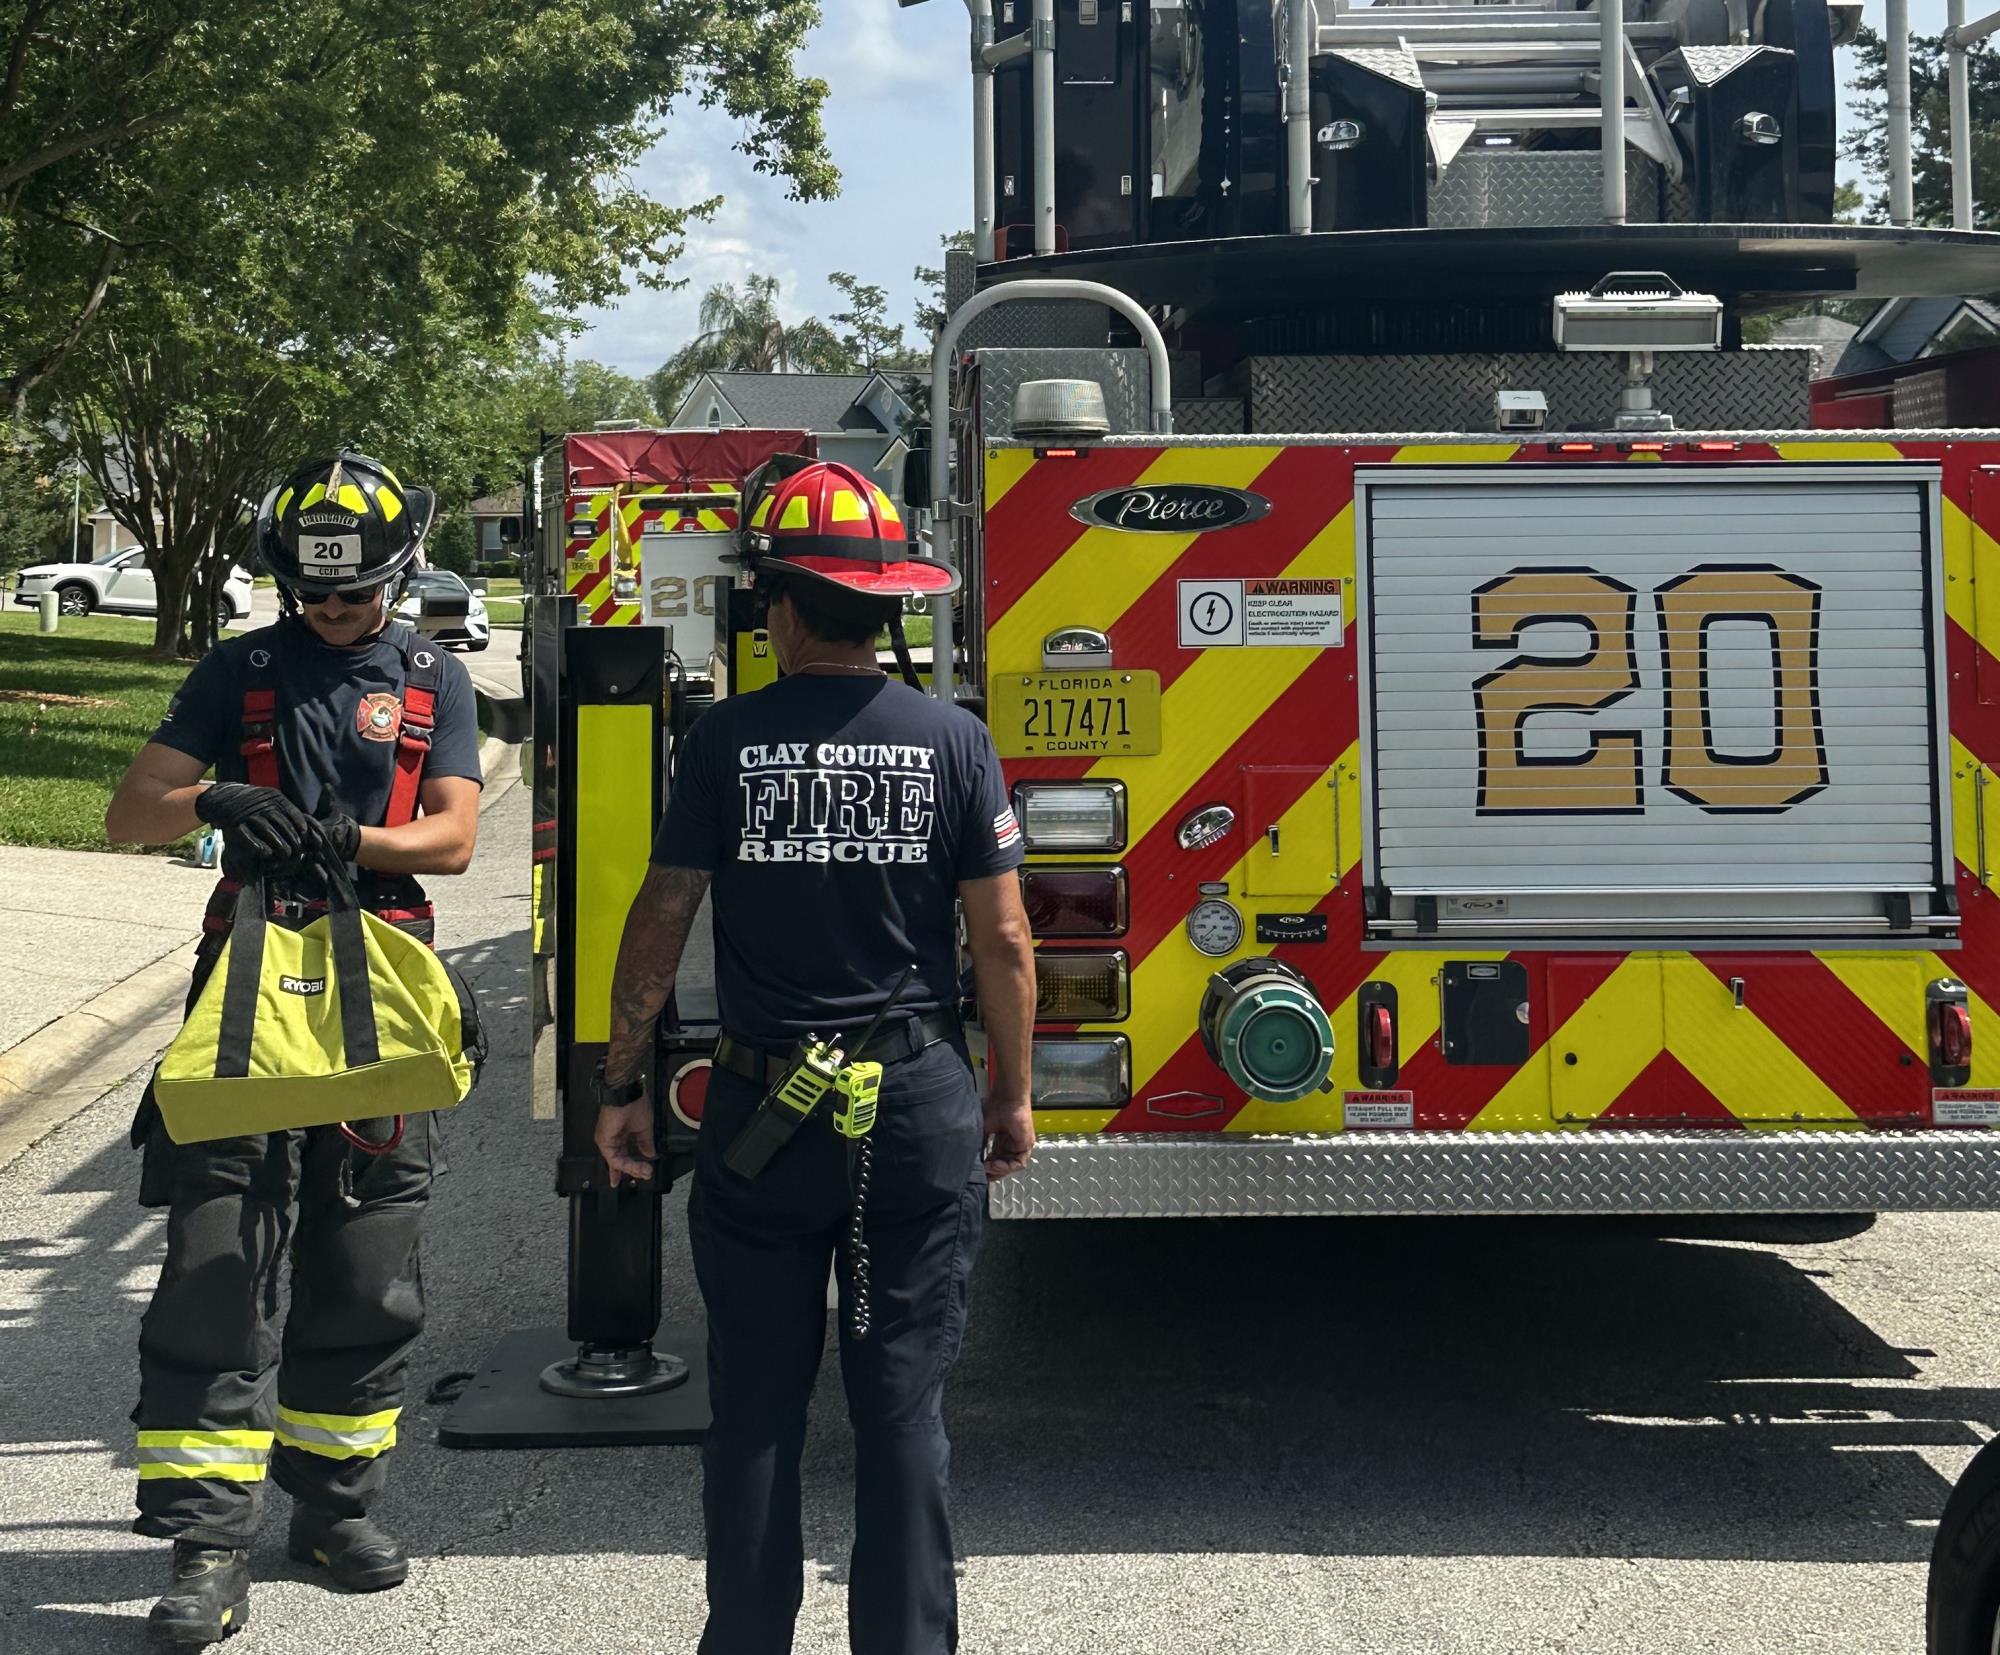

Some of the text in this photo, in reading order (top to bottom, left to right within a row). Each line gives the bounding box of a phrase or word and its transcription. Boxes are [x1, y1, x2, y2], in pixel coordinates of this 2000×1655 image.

[1116, 490, 1225, 525] Pierce
[314, 542, 343, 560] 20
[1266, 581, 1335, 593] WARNING
[1039, 678, 1112, 690] FLORIDA
[1471, 563, 1830, 816] 20
[1024, 697, 1130, 737] 217471
[739, 743, 935, 770] CLAY COUNTY
[1046, 740, 1109, 751] COUNTY
[739, 769, 934, 840] FIRE
[737, 840, 928, 864] RESCUE
[283, 977, 324, 993] RYOBI
